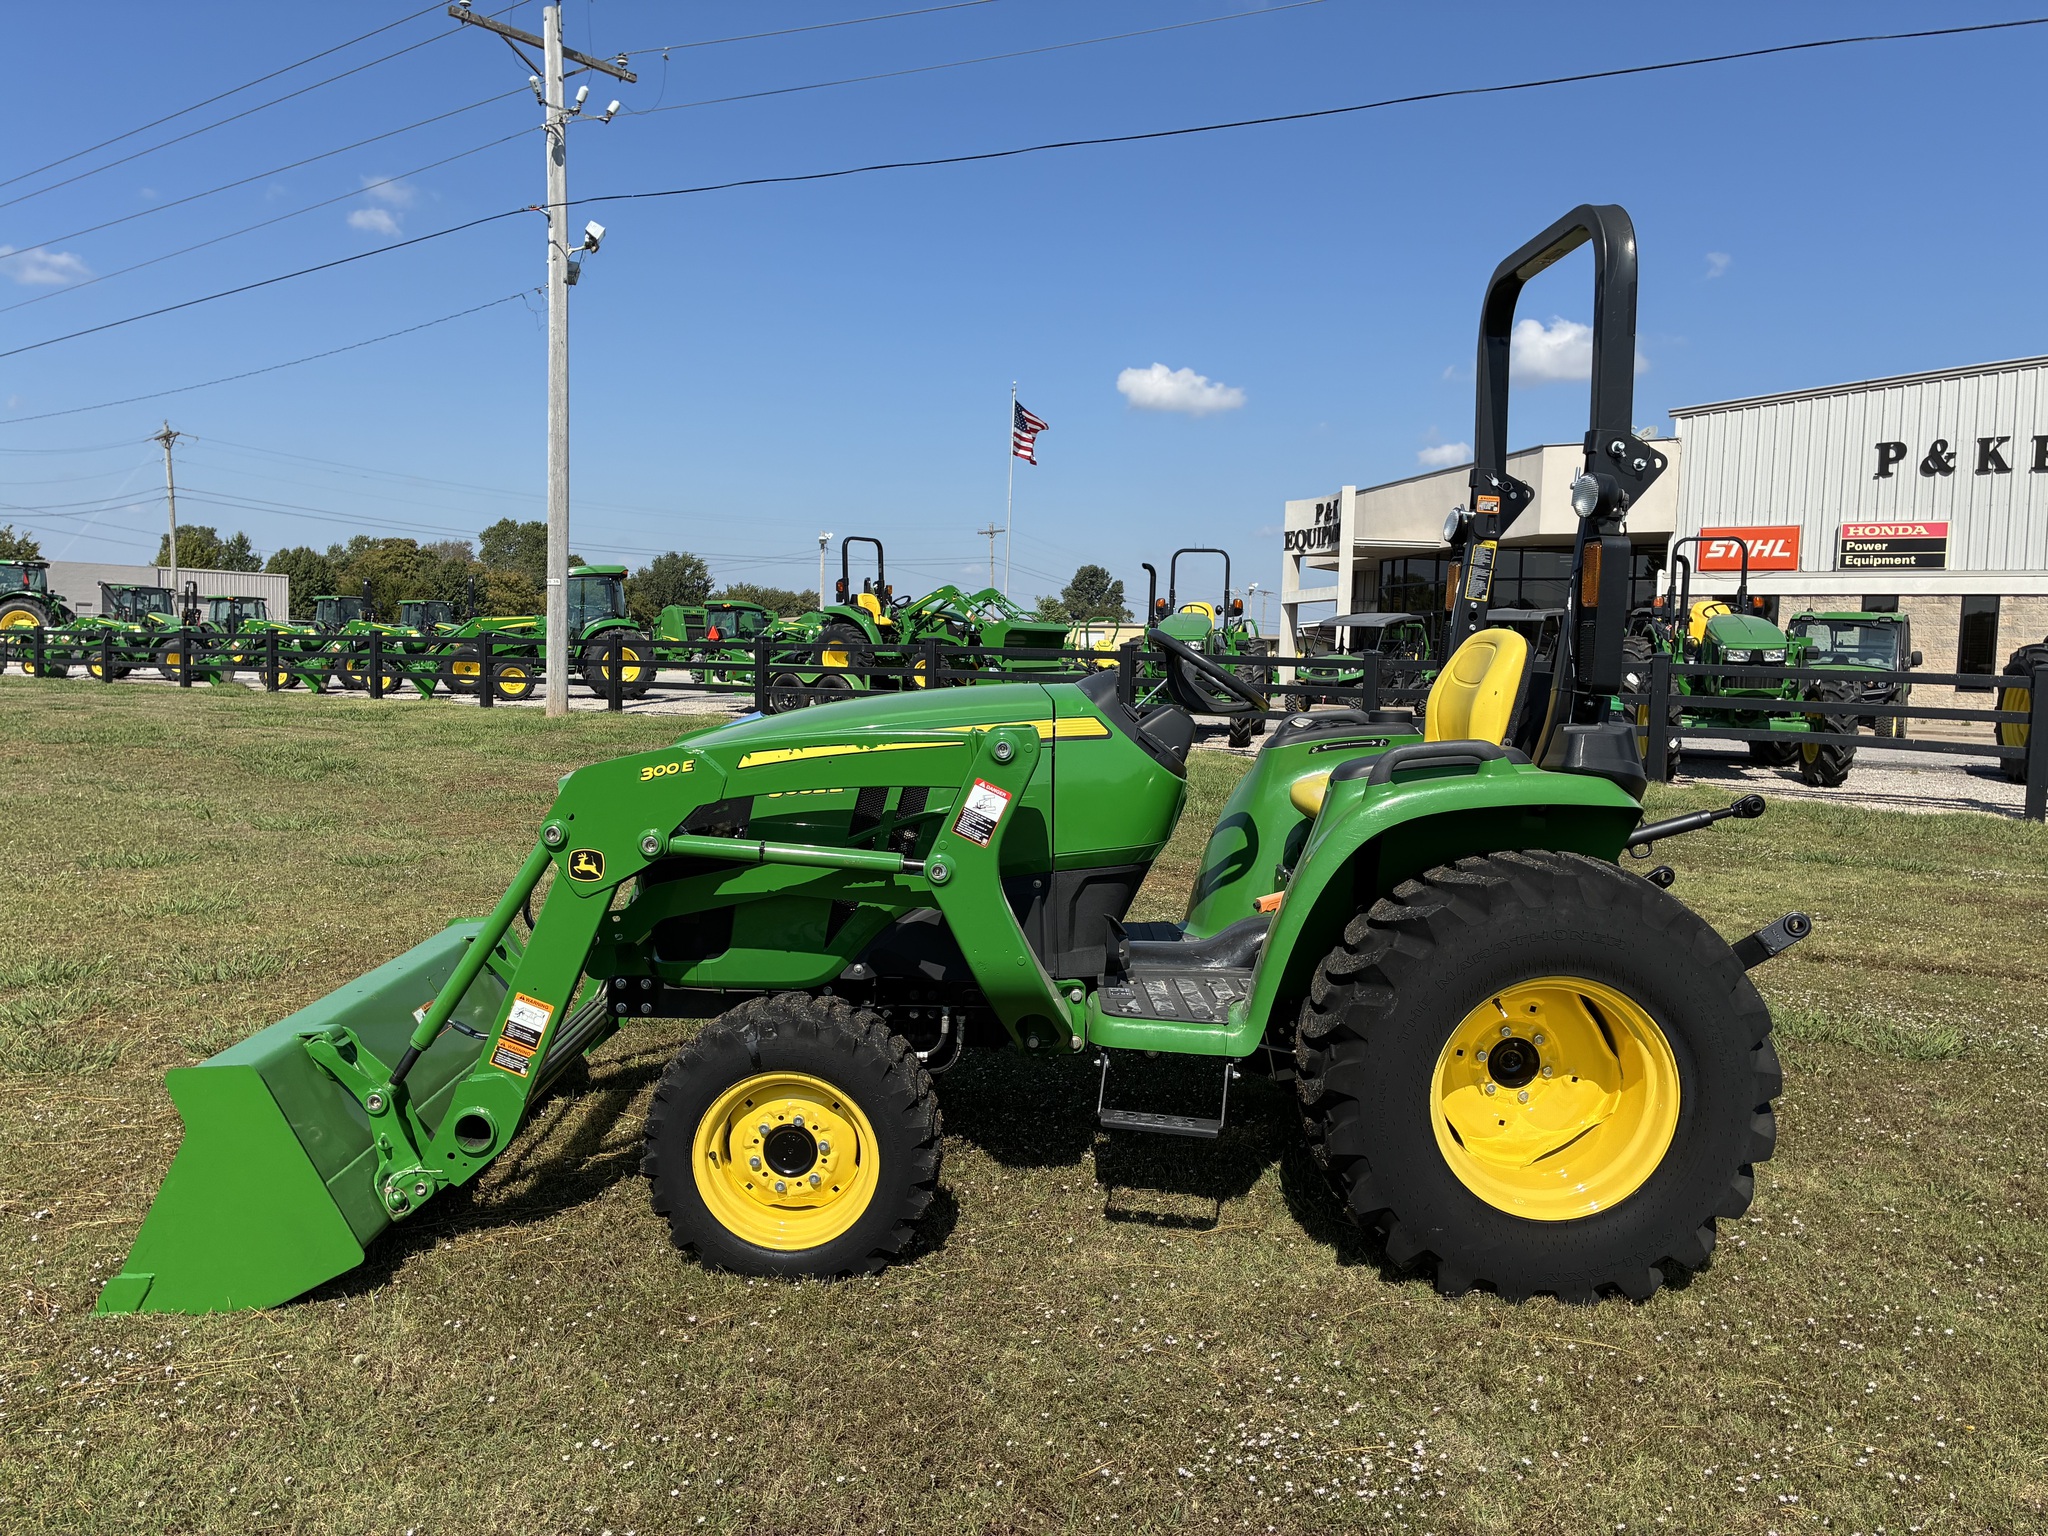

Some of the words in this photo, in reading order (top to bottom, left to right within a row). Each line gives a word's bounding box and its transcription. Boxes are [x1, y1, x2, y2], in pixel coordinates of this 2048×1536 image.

[1873, 441, 1908, 480] P
[1919, 438, 1957, 477] &
[1975, 435, 2013, 476] K
[1847, 525, 1929, 537] HONDA
[1705, 538, 1791, 558] STIHL
[1846, 541, 1888, 551] Power
[1845, 555, 1916, 567] Equipment
[985, 784, 1007, 797] DANGER
[525, 997, 549, 1010] WARNING
[507, 1044, 531, 1056] WARNING
